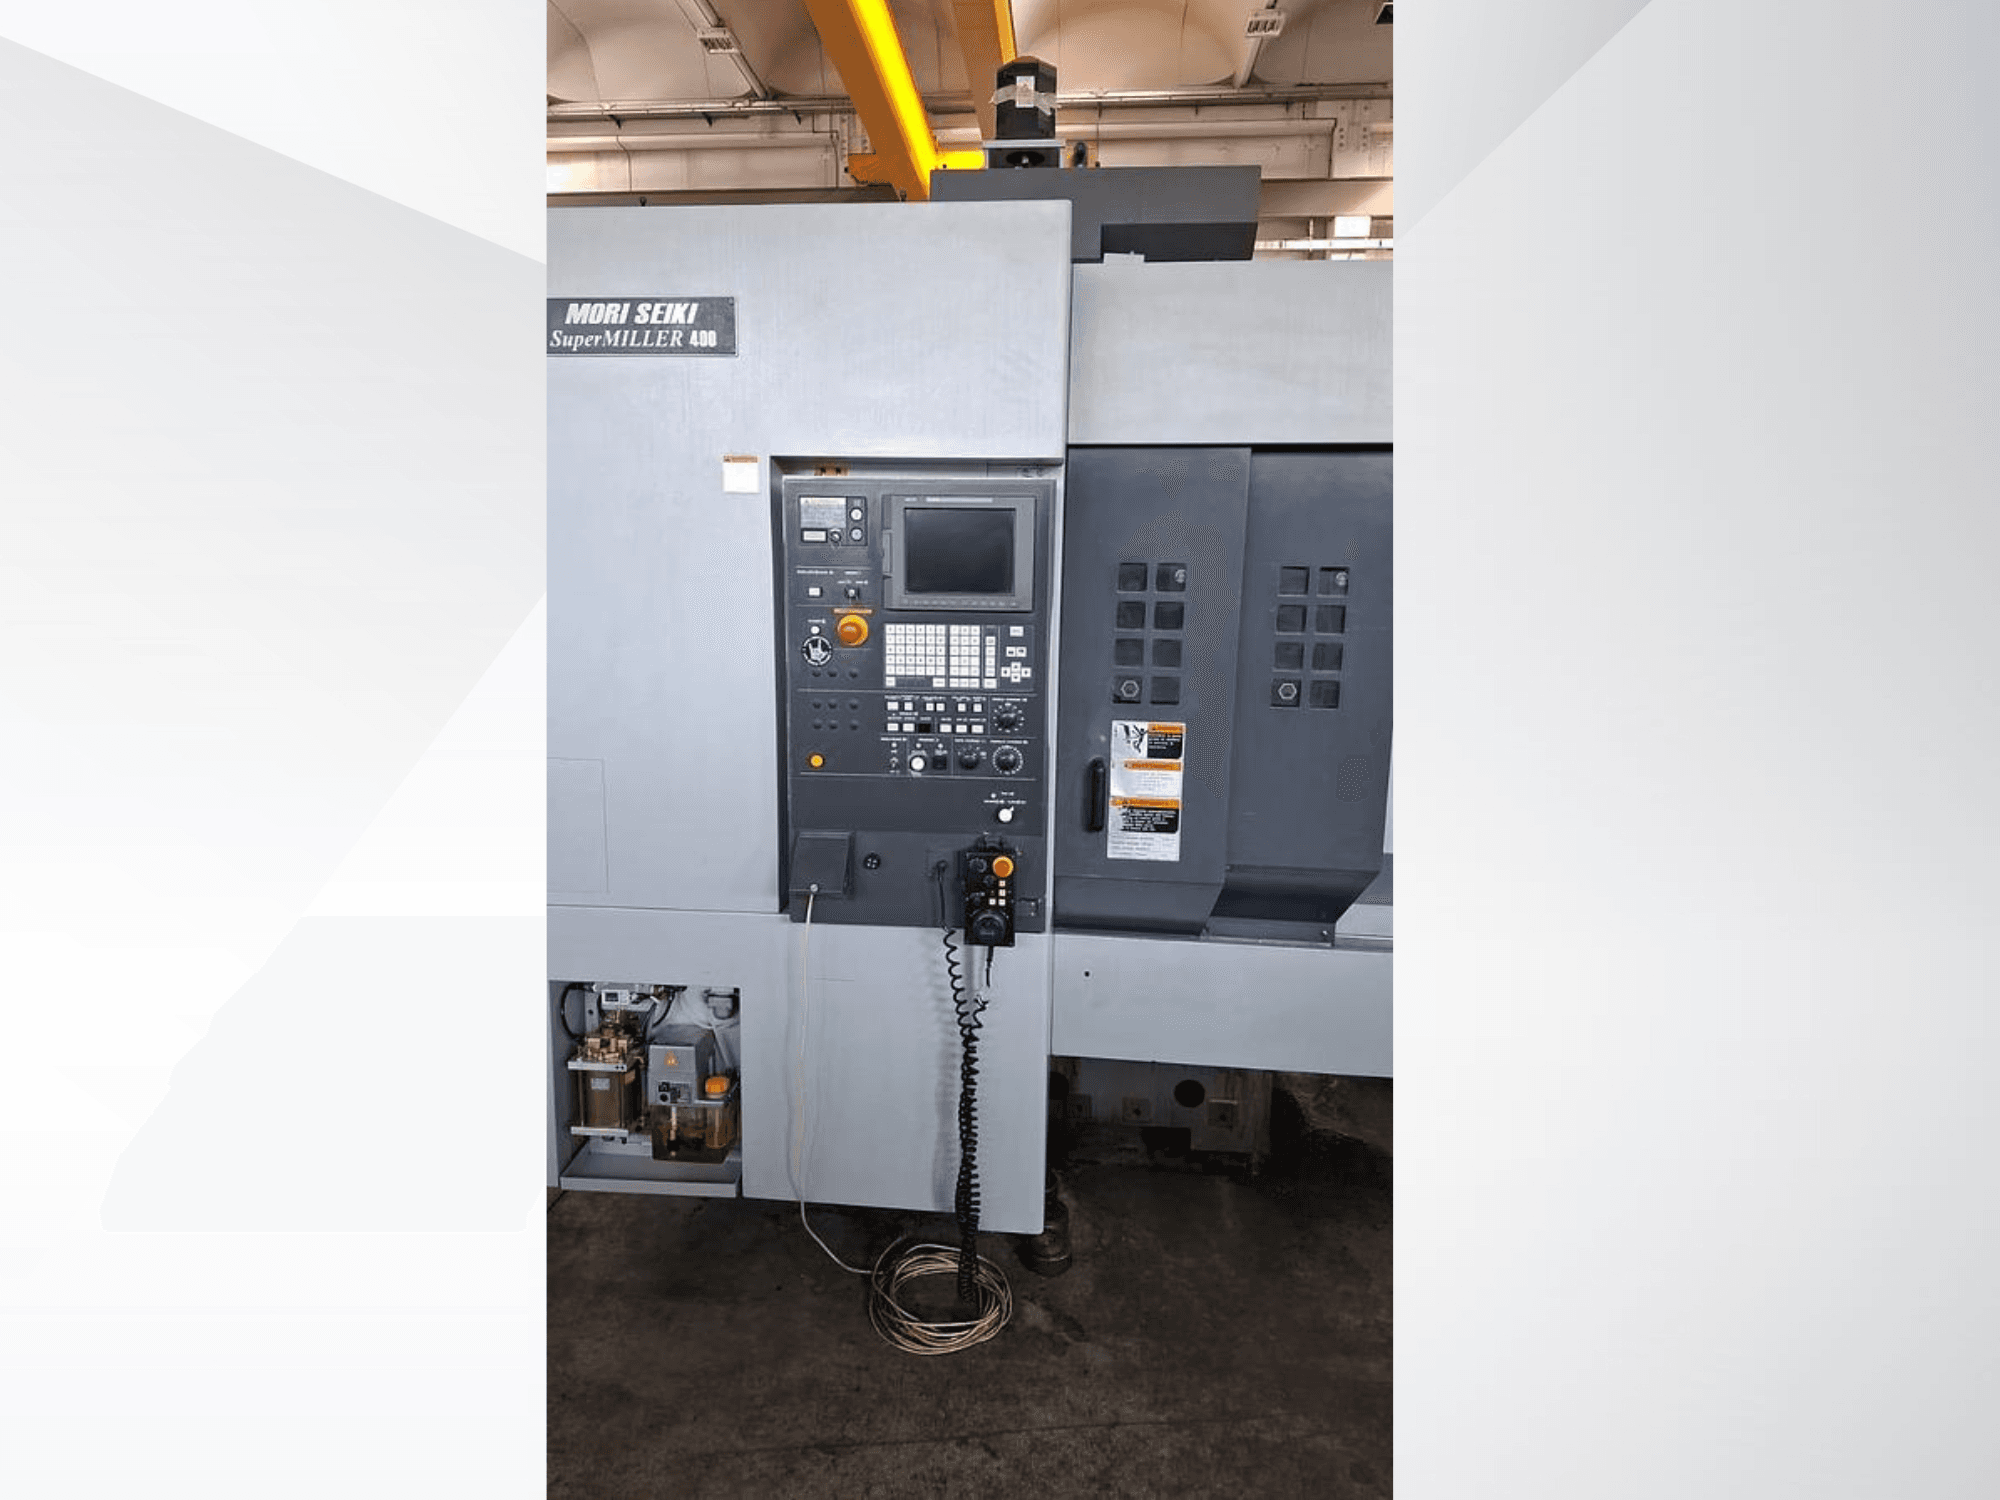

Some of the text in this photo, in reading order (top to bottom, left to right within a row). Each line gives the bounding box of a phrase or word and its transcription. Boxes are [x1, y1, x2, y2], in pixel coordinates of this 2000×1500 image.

[564, 302, 699, 325] MORI SEIKI
[549, 329, 718, 352] SuperMILLER 400
